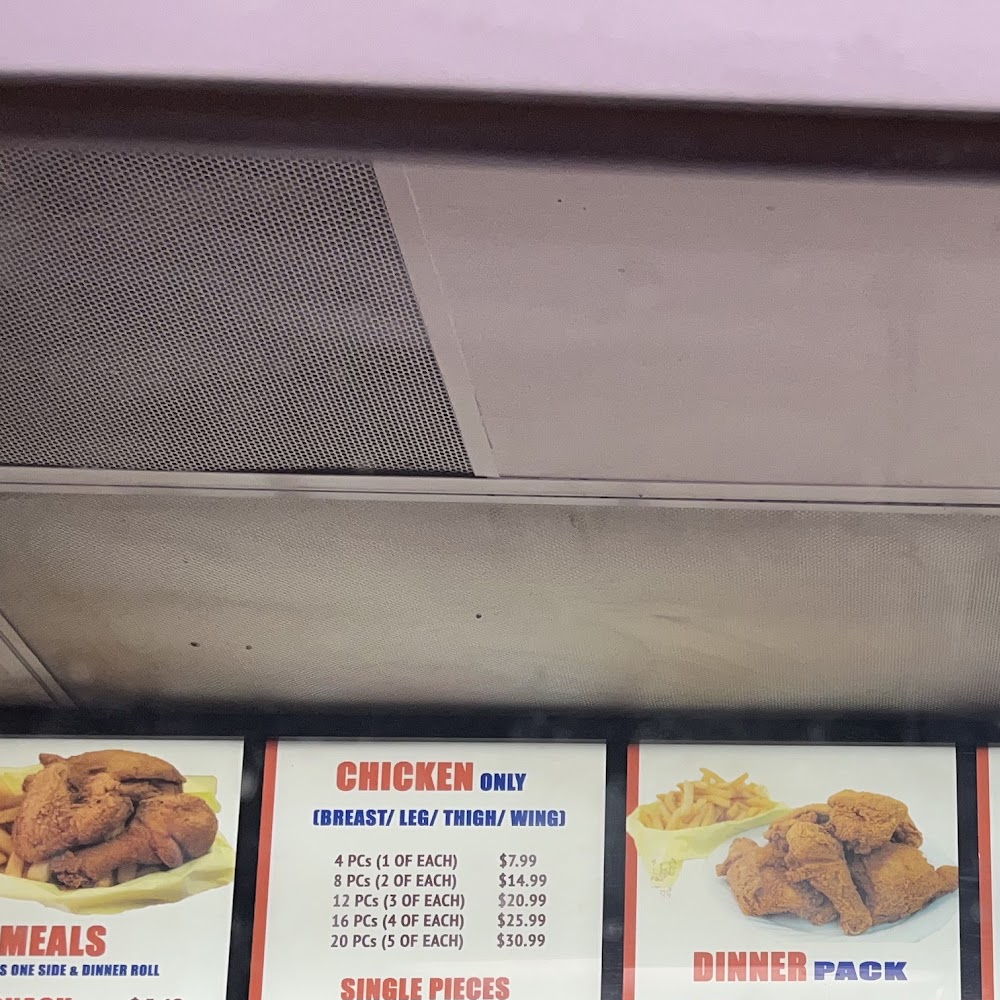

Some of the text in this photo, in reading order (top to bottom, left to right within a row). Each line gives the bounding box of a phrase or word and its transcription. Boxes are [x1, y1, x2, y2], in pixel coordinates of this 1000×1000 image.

[336, 761, 527, 791] CHICKEN ONLY
[399, 809, 439, 826] LEG/
[443, 809, 506, 827] THIGH/
[510, 810, 565, 827] WING)
[334, 854, 457, 870] 4 PCs (1 OF EACH)
[499, 853, 537, 869] $7.99
[0, 925, 106, 957] MEALS
[11, 964, 35, 976] ONE
[38, 964, 67, 976] SIDE
[69, 966, 78, 976] &
[82, 964, 127, 976] DINNER
[130, 964, 159, 976] ROLL
[693, 951, 907, 982] DINNER PACK
[340, 977, 510, 1000] SINGLE PIECES
